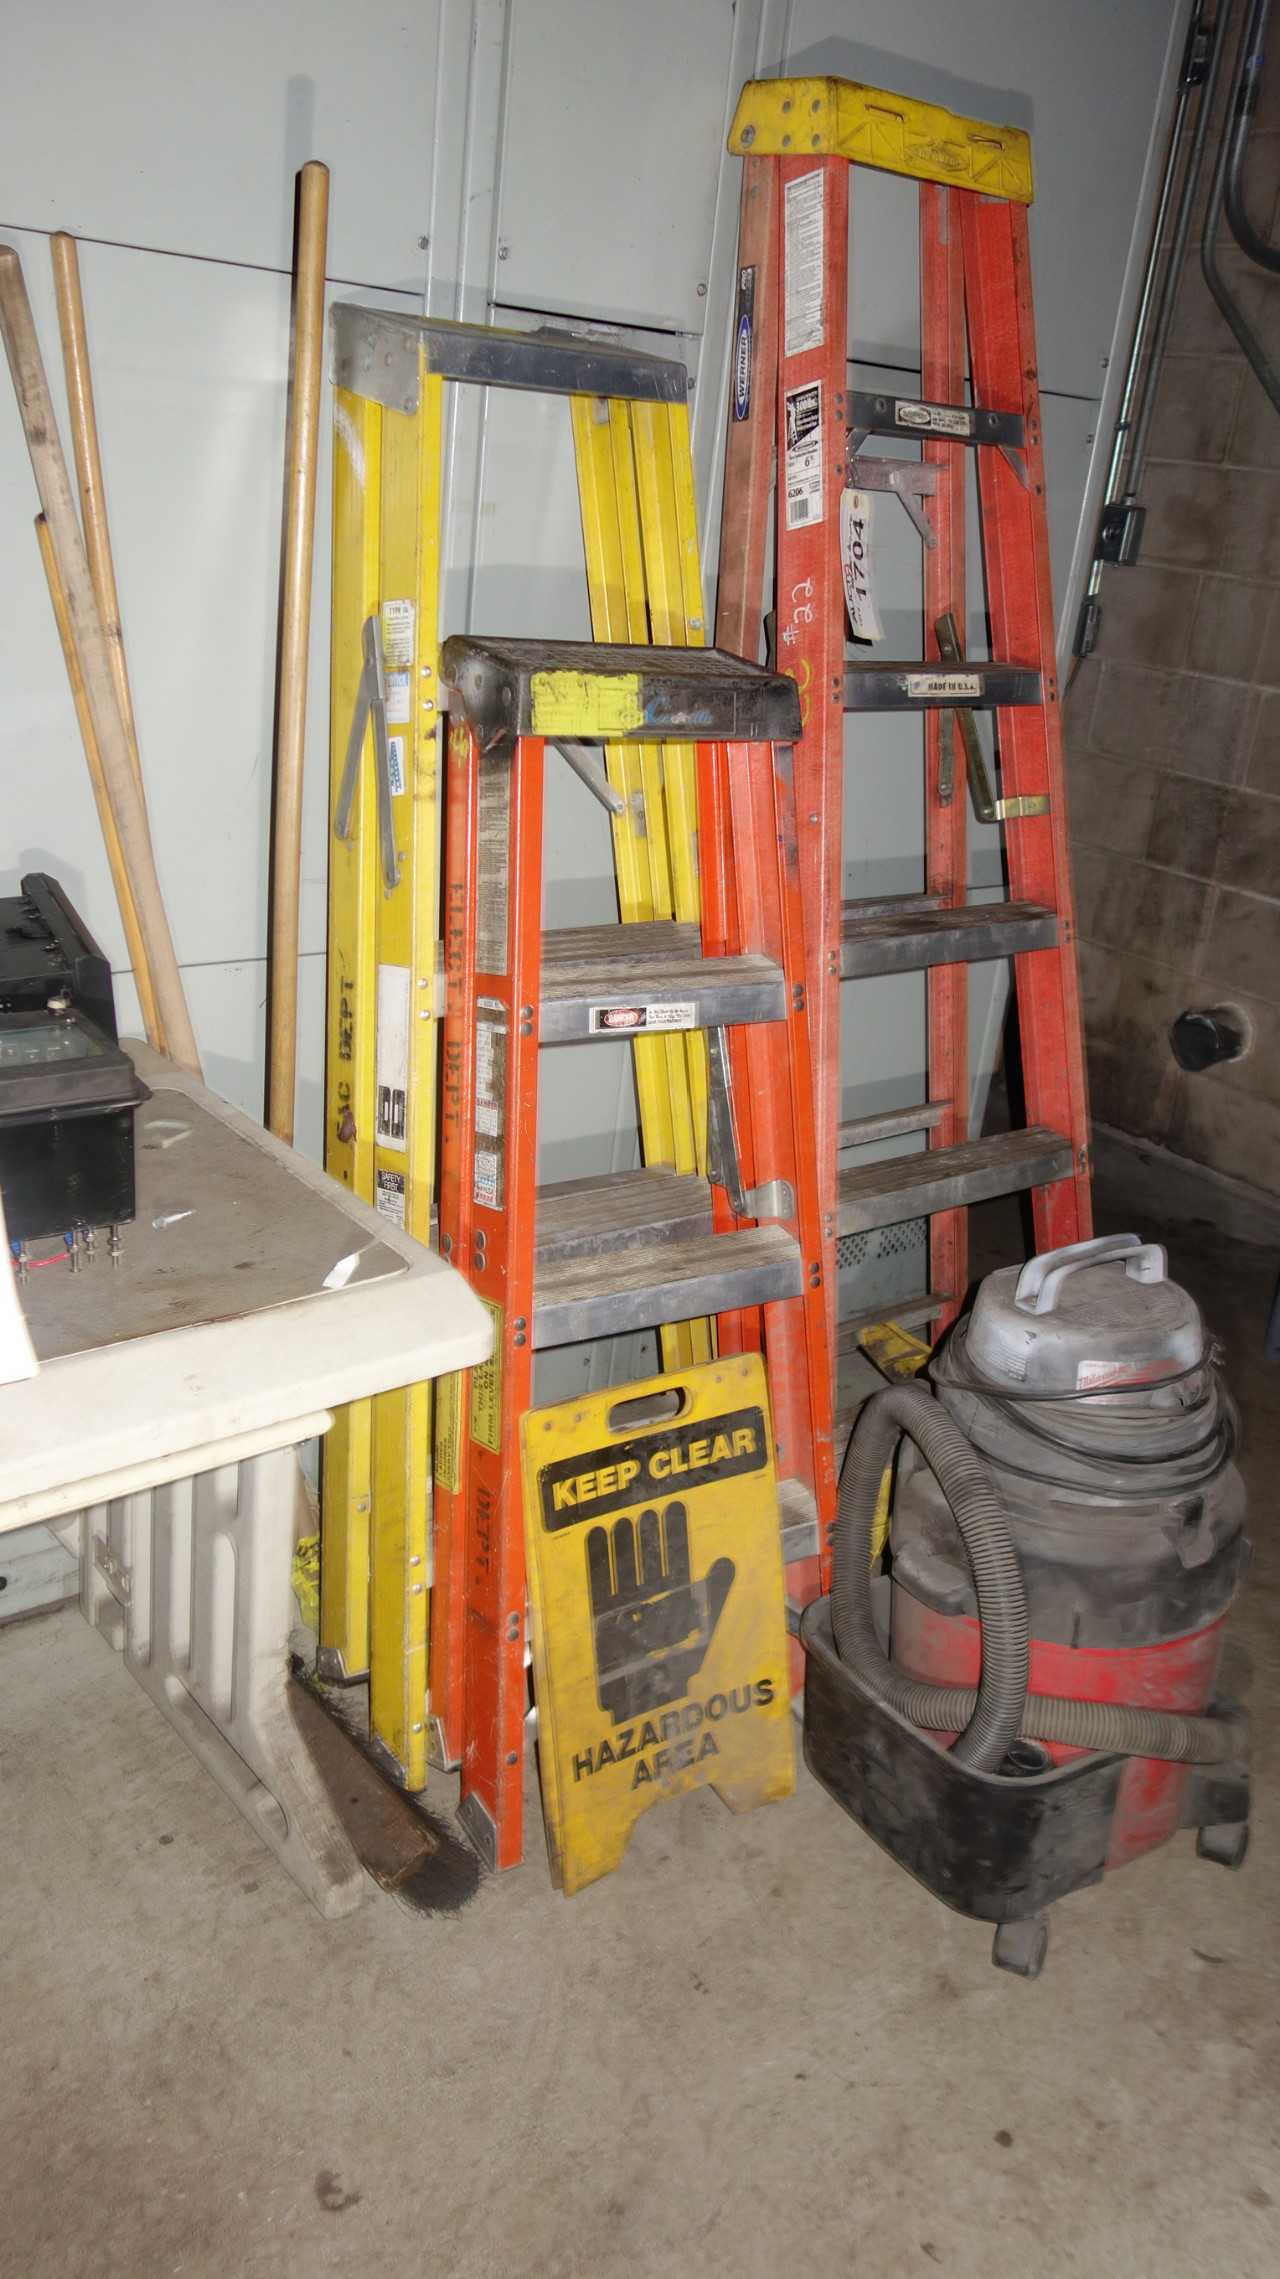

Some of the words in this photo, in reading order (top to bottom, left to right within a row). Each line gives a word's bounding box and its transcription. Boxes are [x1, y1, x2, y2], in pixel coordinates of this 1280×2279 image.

[737, 335, 748, 399] WERNER
[852, 518, 867, 602] 1704
[381, 1171, 401, 1184] SAFETY
[484, 1371, 489, 1389] ON
[552, 1459, 641, 1512] KEEP
[648, 1427, 757, 1480] CLEAR
[572, 1679, 775, 1784] HAZARDOUS
[631, 1731, 721, 1791] AREA
